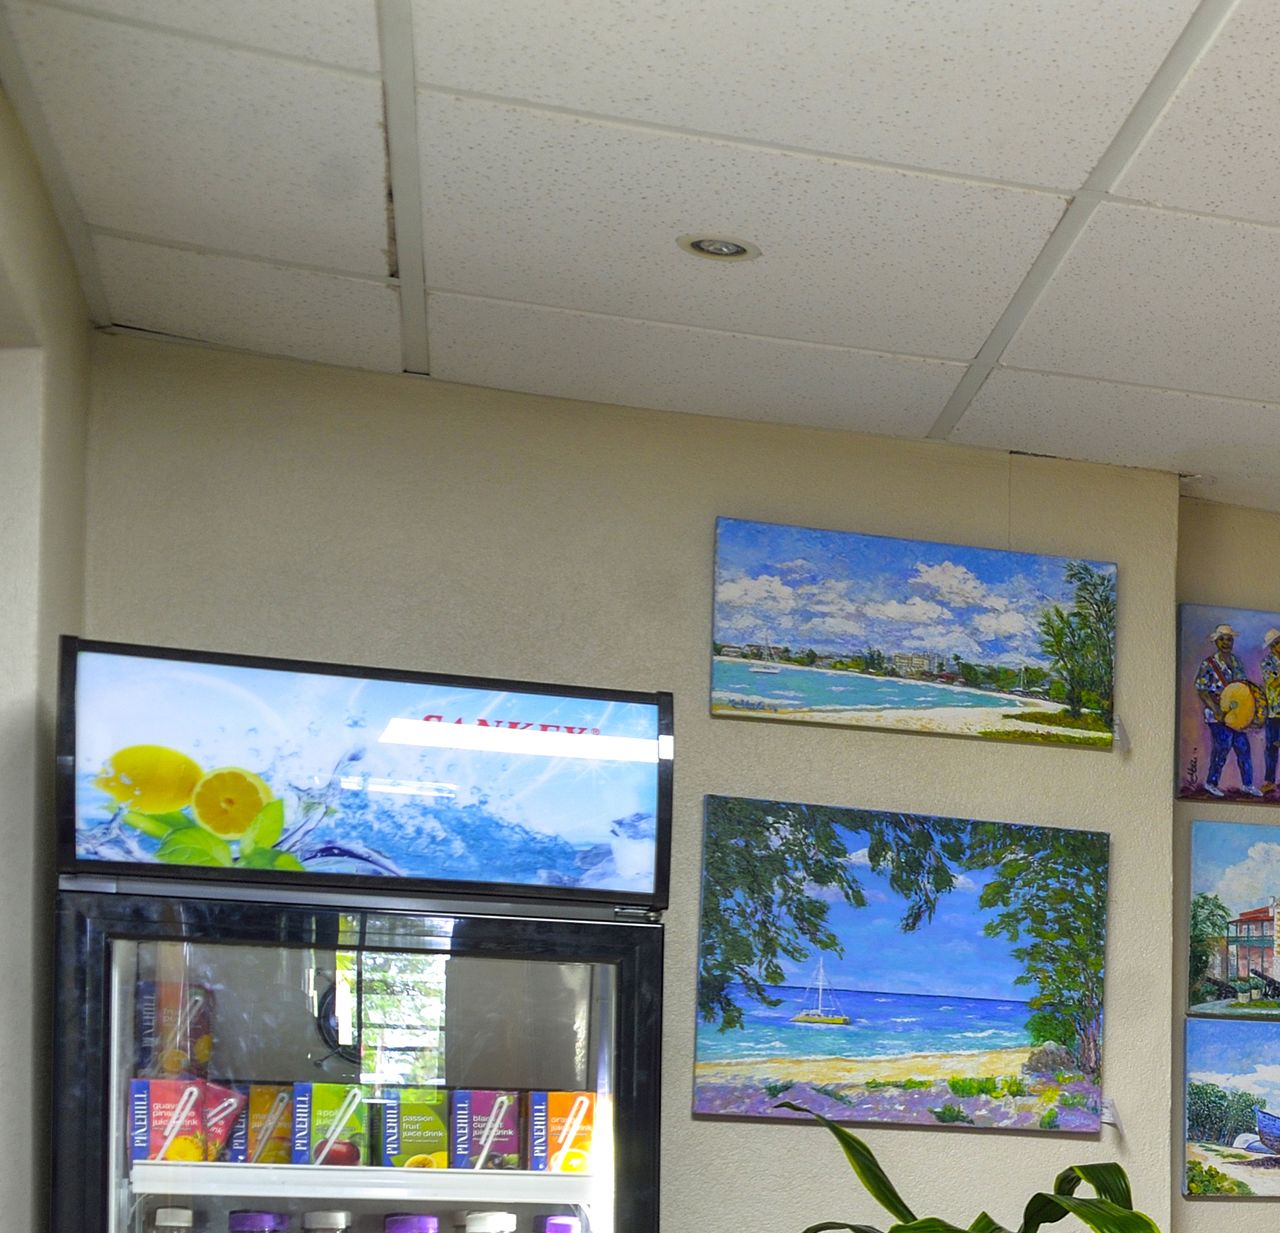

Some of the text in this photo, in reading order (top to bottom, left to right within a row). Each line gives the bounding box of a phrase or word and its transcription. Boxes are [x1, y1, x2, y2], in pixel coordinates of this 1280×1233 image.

[134, 1090, 148, 1148] PINEHILL
[295, 1093, 310, 1151] PINEHILL
[386, 1100, 399, 1155] PINEHILL
[402, 1115, 433, 1123] passion
[402, 1123, 420, 1131] fruit
[402, 1130, 444, 1138] juice drink
[457, 1100, 469, 1155] PINEHILL
[533, 1102, 546, 1157] PINEHILL
